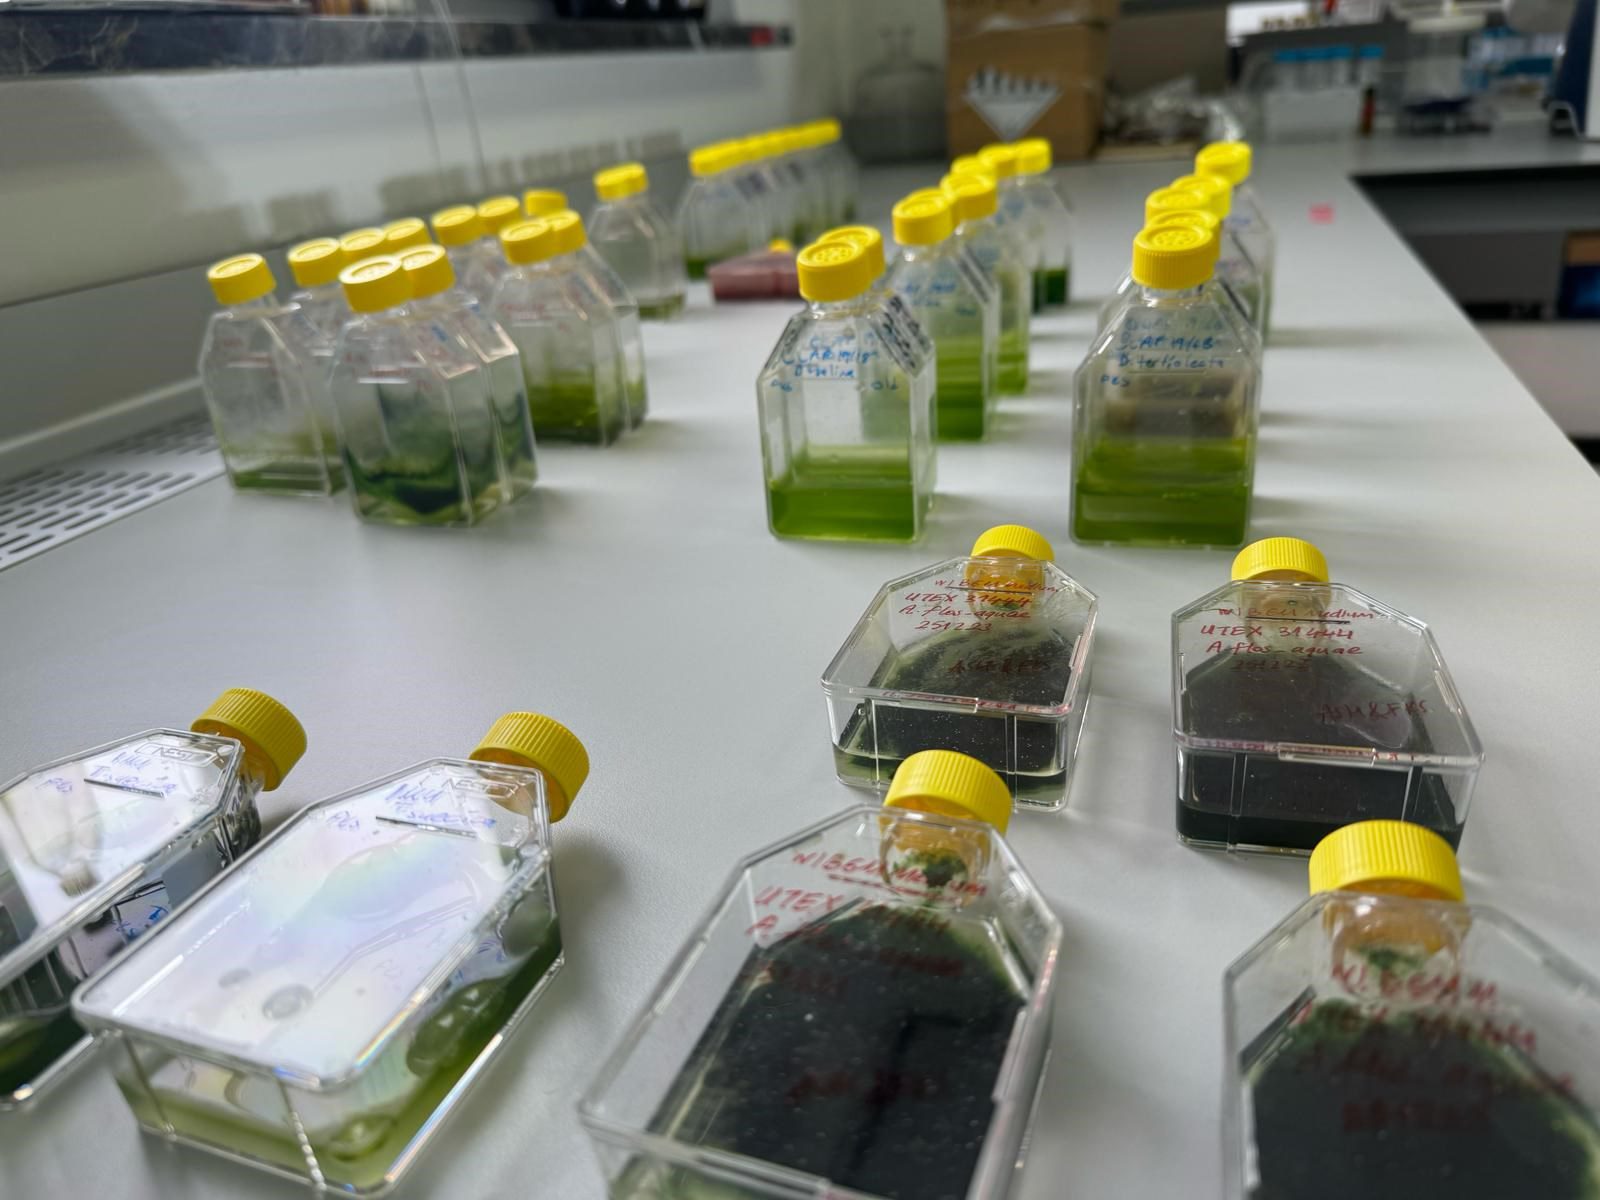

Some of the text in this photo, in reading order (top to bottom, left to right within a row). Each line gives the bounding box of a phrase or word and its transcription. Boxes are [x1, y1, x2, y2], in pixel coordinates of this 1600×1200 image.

[904, 592, 960, 603] UTEX
[1199, 624, 1264, 637] UTEX
[753, 885, 845, 912] UTEX
